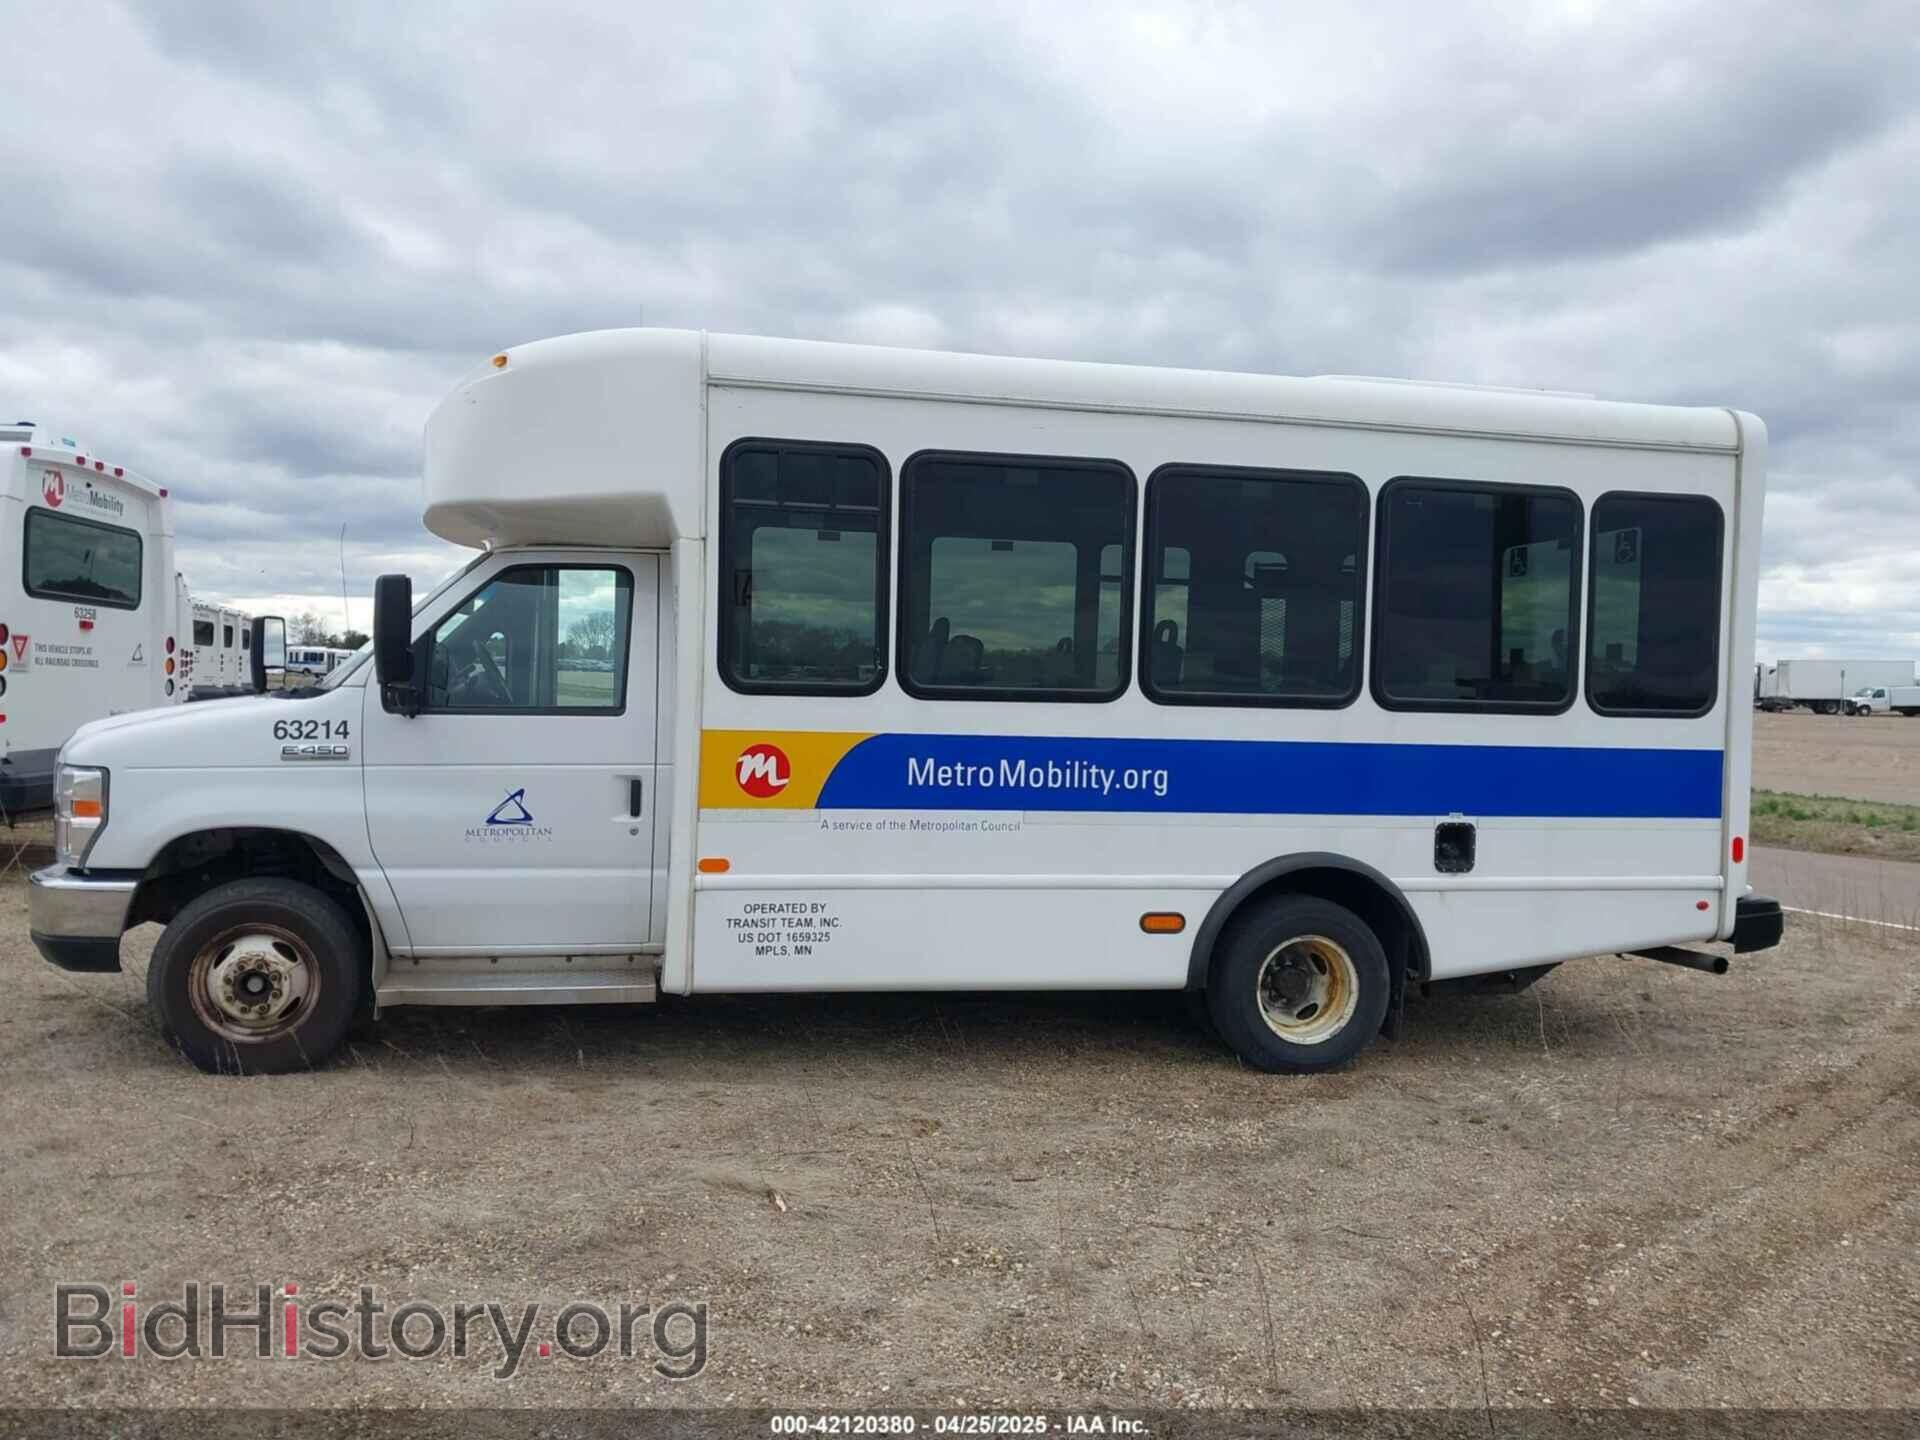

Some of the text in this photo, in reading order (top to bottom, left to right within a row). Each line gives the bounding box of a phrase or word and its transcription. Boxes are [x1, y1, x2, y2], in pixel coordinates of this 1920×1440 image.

[273, 720, 350, 740] 63214
[465, 827, 552, 837] METROPOLITAN
[821, 819, 1021, 833] A service of the Metropolitan Council
[743, 903, 826, 914] OPERATED BY
[727, 916, 842, 929] TRANSIT TEAM, INC.
[738, 931, 831, 943] US DOT 1659325
[755, 945, 812, 957] MPLS, MN
